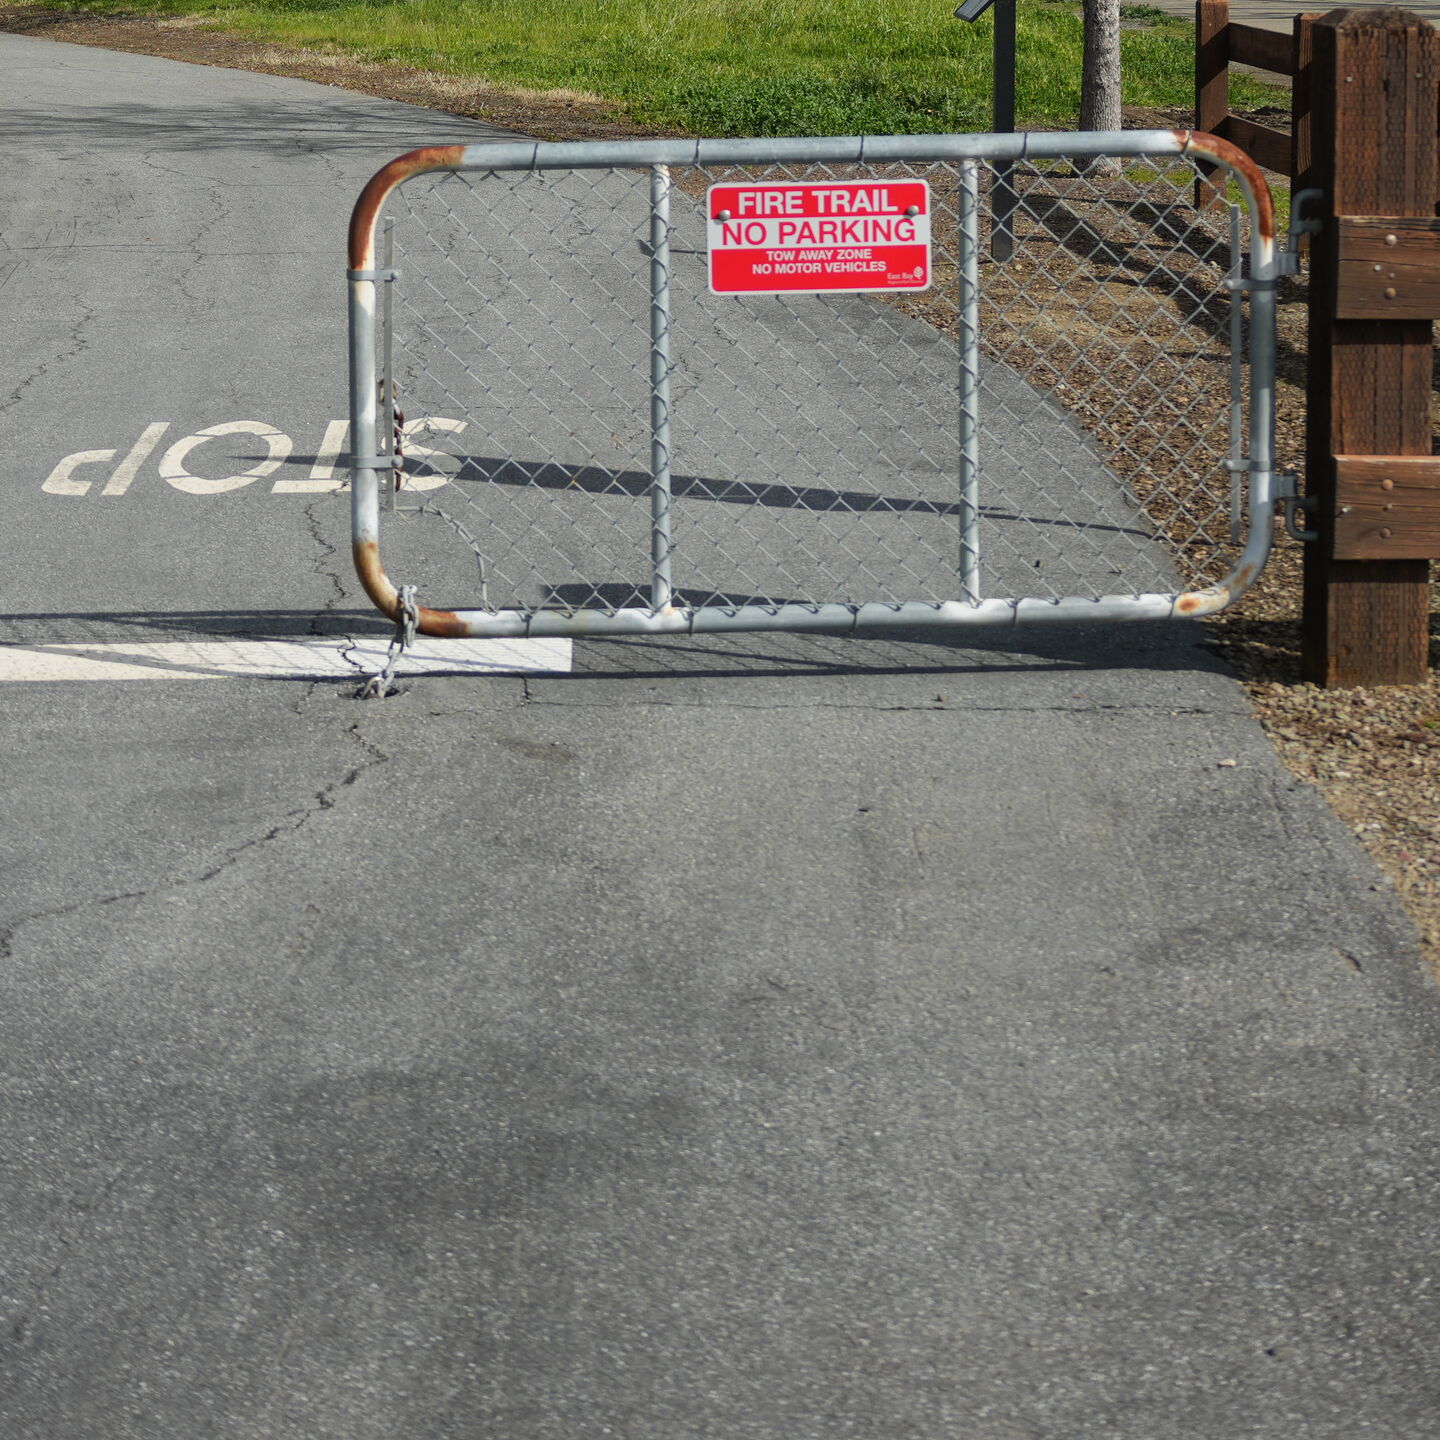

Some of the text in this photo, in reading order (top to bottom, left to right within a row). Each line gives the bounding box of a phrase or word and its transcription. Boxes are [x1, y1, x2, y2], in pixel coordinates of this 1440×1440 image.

[738, 189, 898, 215] FIRE TRAIL
[722, 218, 916, 246] NO PARKING
[766, 248, 872, 261] TOW AWAY ZONE
[752, 261, 886, 274] NO MOTOR VEHICLES
[887, 272, 901, 280] East
[40, 417, 468, 495] STOP
